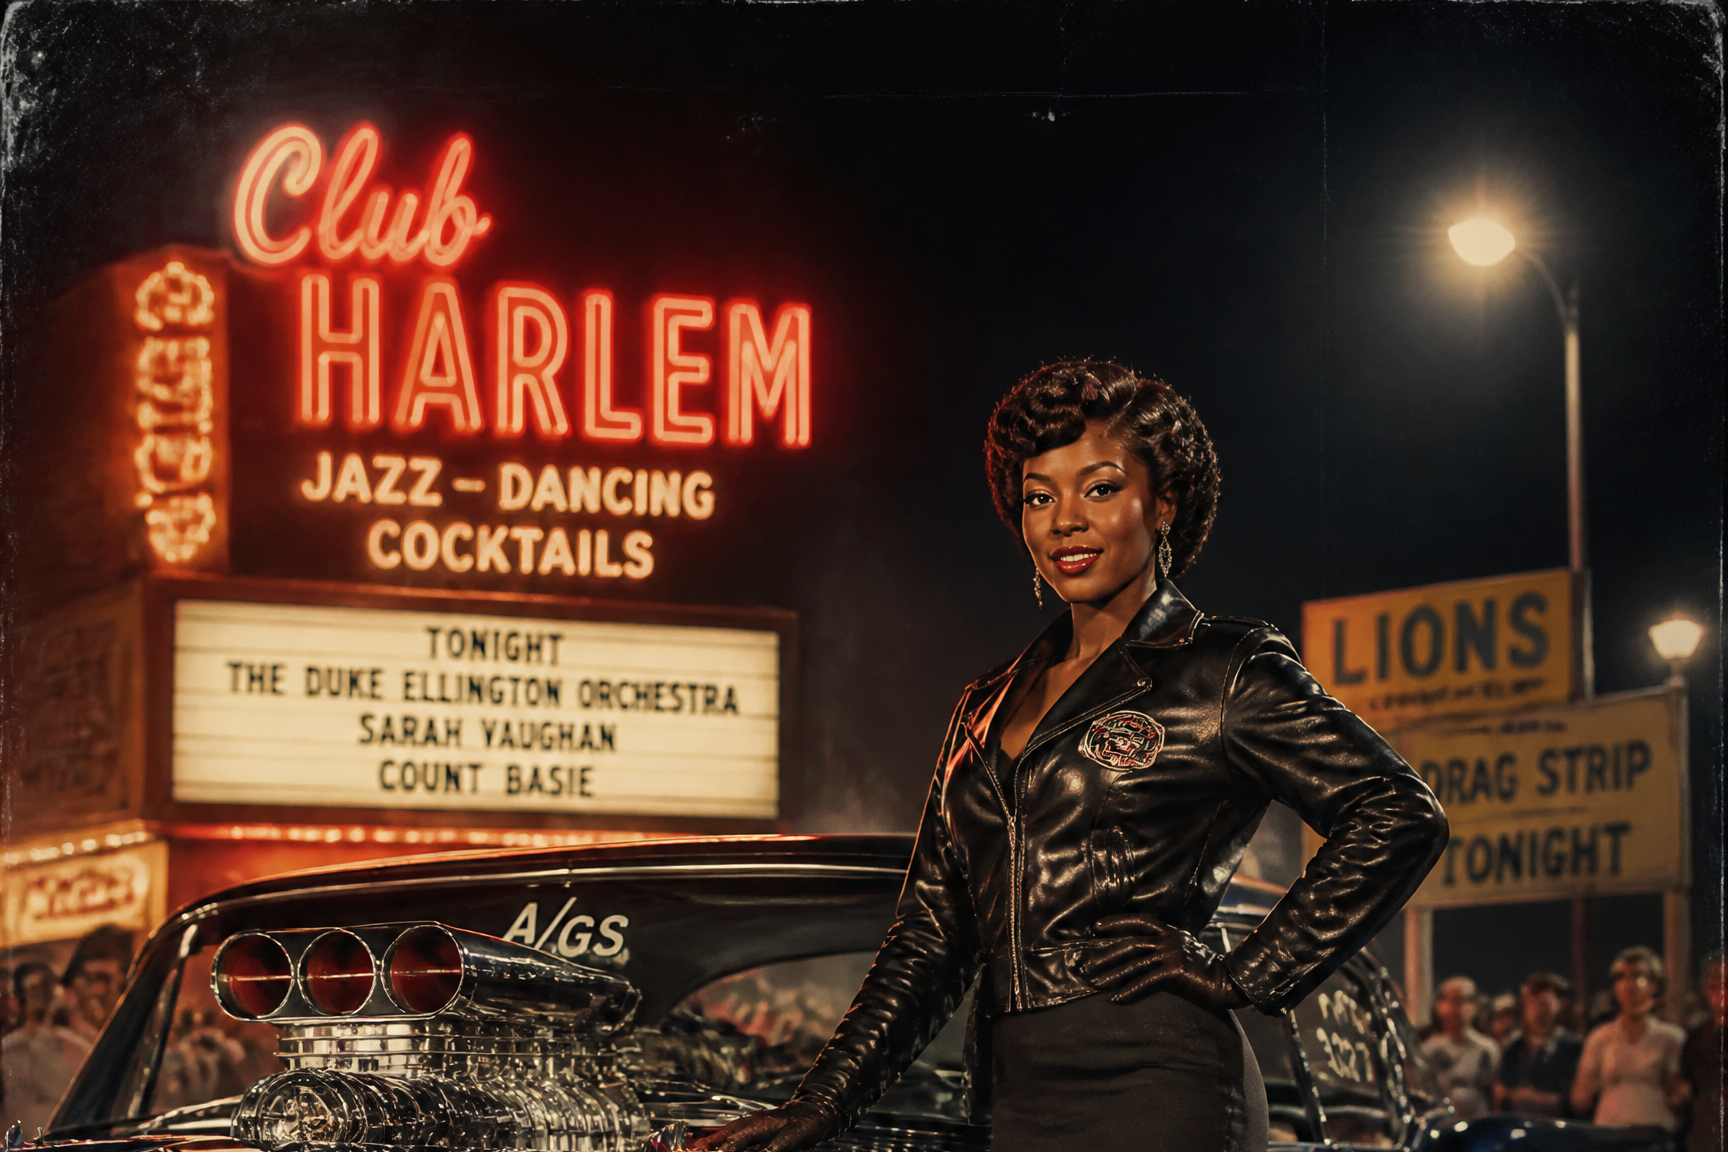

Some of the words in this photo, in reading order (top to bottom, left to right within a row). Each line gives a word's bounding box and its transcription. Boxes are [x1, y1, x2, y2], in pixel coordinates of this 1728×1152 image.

[232, 121, 492, 269] Club
[298, 270, 814, 450] HARLEM
[301, 451, 443, 507] JAZZ
[500, 463, 716, 519] DANCING
[368, 519, 655, 579] COCKTAILS
[426, 626, 563, 665] TONIGHT
[1332, 592, 1549, 685] LIONS
[226, 661, 285, 695] THE
[305, 665, 383, 699] DUKE
[403, 670, 562, 708] ELLINGTON
[578, 679, 740, 715] ORCHESTRA
[358, 713, 462, 746] SARAH
[482, 717, 617, 752] VAUGHAN
[379, 759, 482, 793] COUNT
[506, 764, 595, 797] BASIE
[1421, 752, 1518, 804] DRAG
[1536, 740, 1652, 795] STRIP
[1442, 821, 1631, 885] TONIGHT
[502, 896, 630, 958] A/GS
